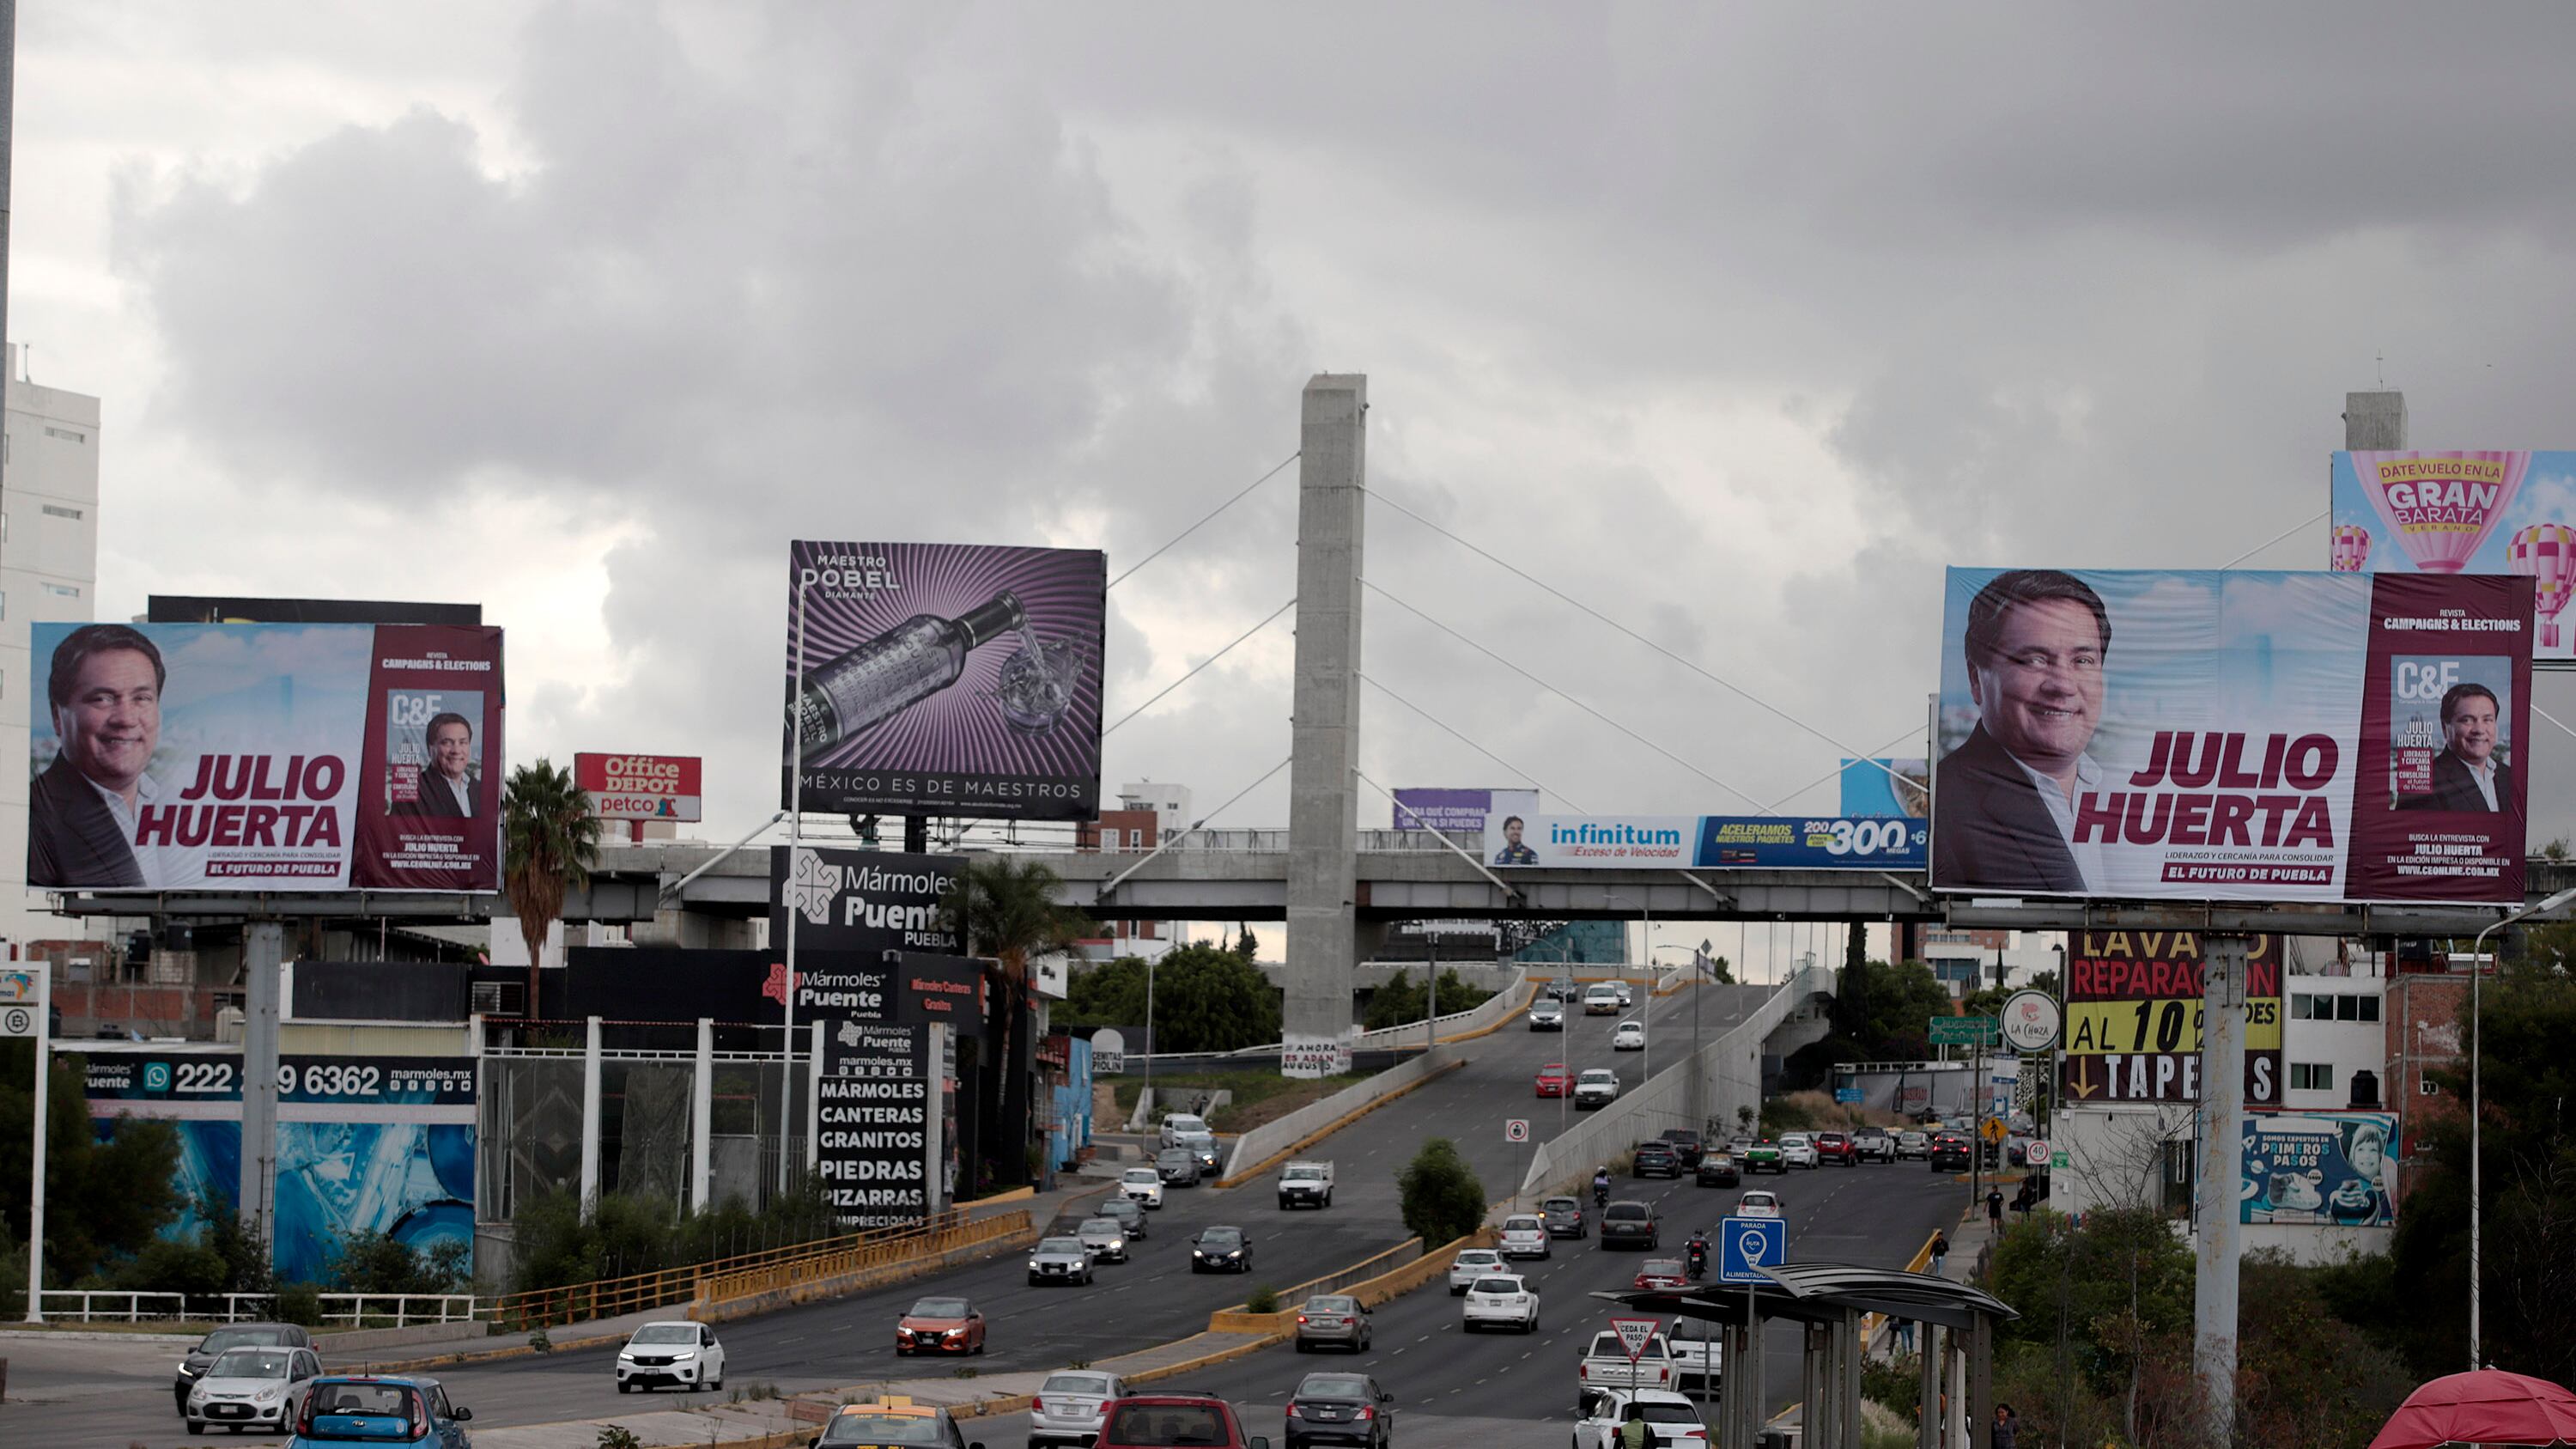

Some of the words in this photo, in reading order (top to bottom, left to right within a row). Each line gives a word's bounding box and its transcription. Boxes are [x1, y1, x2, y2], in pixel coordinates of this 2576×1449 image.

[2381, 464, 2415, 478] DATE
[2418, 462, 2461, 475] VUELO
[2464, 464, 2482, 476] EN
[2484, 466, 2501, 479] LA
[2386, 481, 2500, 509] GRAN
[2394, 507, 2483, 525] BARATA
[817, 554, 886, 568] MAESTRO
[801, 568, 901, 590] DOBEL
[824, 591, 876, 600] DIAMANTE
[2384, 618, 2450, 630] CAMPAIGNS
[2451, 618, 2460, 630] &
[2461, 618, 2521, 631] ELECTIONS
[382, 658, 434, 670] CAMPAIGNS
[443, 661, 491, 672] ELECTIONS
[2406, 721, 2433, 734] JULIO
[2397, 734, 2433, 747] HUERTA
[2128, 730, 2340, 790] JULIO
[605, 757, 680, 778] Office
[179, 754, 346, 801] JULIO
[605, 776, 679, 794] DEPOT
[799, 772, 880, 791] MÉXICO
[892, 778, 916, 793] ES
[927, 779, 954, 794] DE
[965, 782, 1081, 799] MAESTROS
[601, 796, 654, 813] petco
[1445, 807, 1485, 817] COMPRAR
[135, 804, 342, 848] HUERTA
[1449, 818, 1482, 828] PUEDES
[2072, 791, 2335, 849] HUERTA
[1552, 823, 1680, 844] infinitum
[1719, 824, 1793, 836] ACELERAMOS
[1803, 821, 1830, 834] 200
[1826, 819, 1907, 855] 300
[1716, 834, 1755, 843] NUESTROS
[1757, 835, 1795, 844] PAQUETES
[2439, 834, 2476, 843] ENTREVISTA
[404, 843, 426, 852] JULIO
[428, 843, 459, 853] HUERTA
[1575, 846, 1612, 857] Exceso
[1614, 846, 1627, 857] de
[1631, 847, 1680, 858] Velocidad
[2415, 844, 2443, 855] JULIO
[2444, 844, 2483, 856] HUERTA
[2165, 851, 2209, 860] LIDERAZGO
[2217, 851, 2257, 861] CERCANÍA
[2281, 854, 2335, 862] CONSOLIDAR
[2405, 855, 2430, 864] EDICIÓN
[2431, 856, 2458, 865] IMPRESA
[210, 863, 223, 874] EL
[226, 863, 272, 874] FUTURO
[274, 863, 289, 874] DE
[291, 864, 336, 874] PUEBLA
[2168, 866, 2184, 879] EL
[2187, 867, 2246, 880] FUTURO
[2249, 868, 2268, 880] DE
[2271, 868, 2327, 881] PUEBLA
[2397, 865, 2500, 877] WWW.CEONLINE.COM.MX
[845, 865, 958, 895] Mármoles
[904, 931, 957, 948] PUEBLA
[801, 969, 881, 988] Mármoles
[799, 989, 883, 1008] Puente
[863, 1025, 911, 1036] Mármoles
[2011, 1023, 2020, 1035] LA
[2024, 1023, 2049, 1038] CHOZA
[2073, 1016, 2116, 1050] AL
[863, 1036, 912, 1048] Puente
[839, 1056, 913, 1067] marmoles.mx
[1303, 1054, 1334, 1062] ADAN
[1284, 1062, 1331, 1070] AUGUSO
[175, 1062, 233, 1093] 222
[303, 1065, 380, 1095] 6362
[391, 1068, 471, 1081] marmoles.mx
[2105, 1055, 2272, 1101] TAPES
[821, 1079, 925, 1099] MÁRMOLES
[820, 1106, 924, 1123] CANTERAS
[820, 1131, 923, 1148] GRANITOS
[2032, 1146, 2044, 1155] 40
[2261, 1142, 2330, 1155] PRIMEROS
[2273, 1154, 2318, 1166] PASOS
[820, 1160, 922, 1180] PIEDRAS
